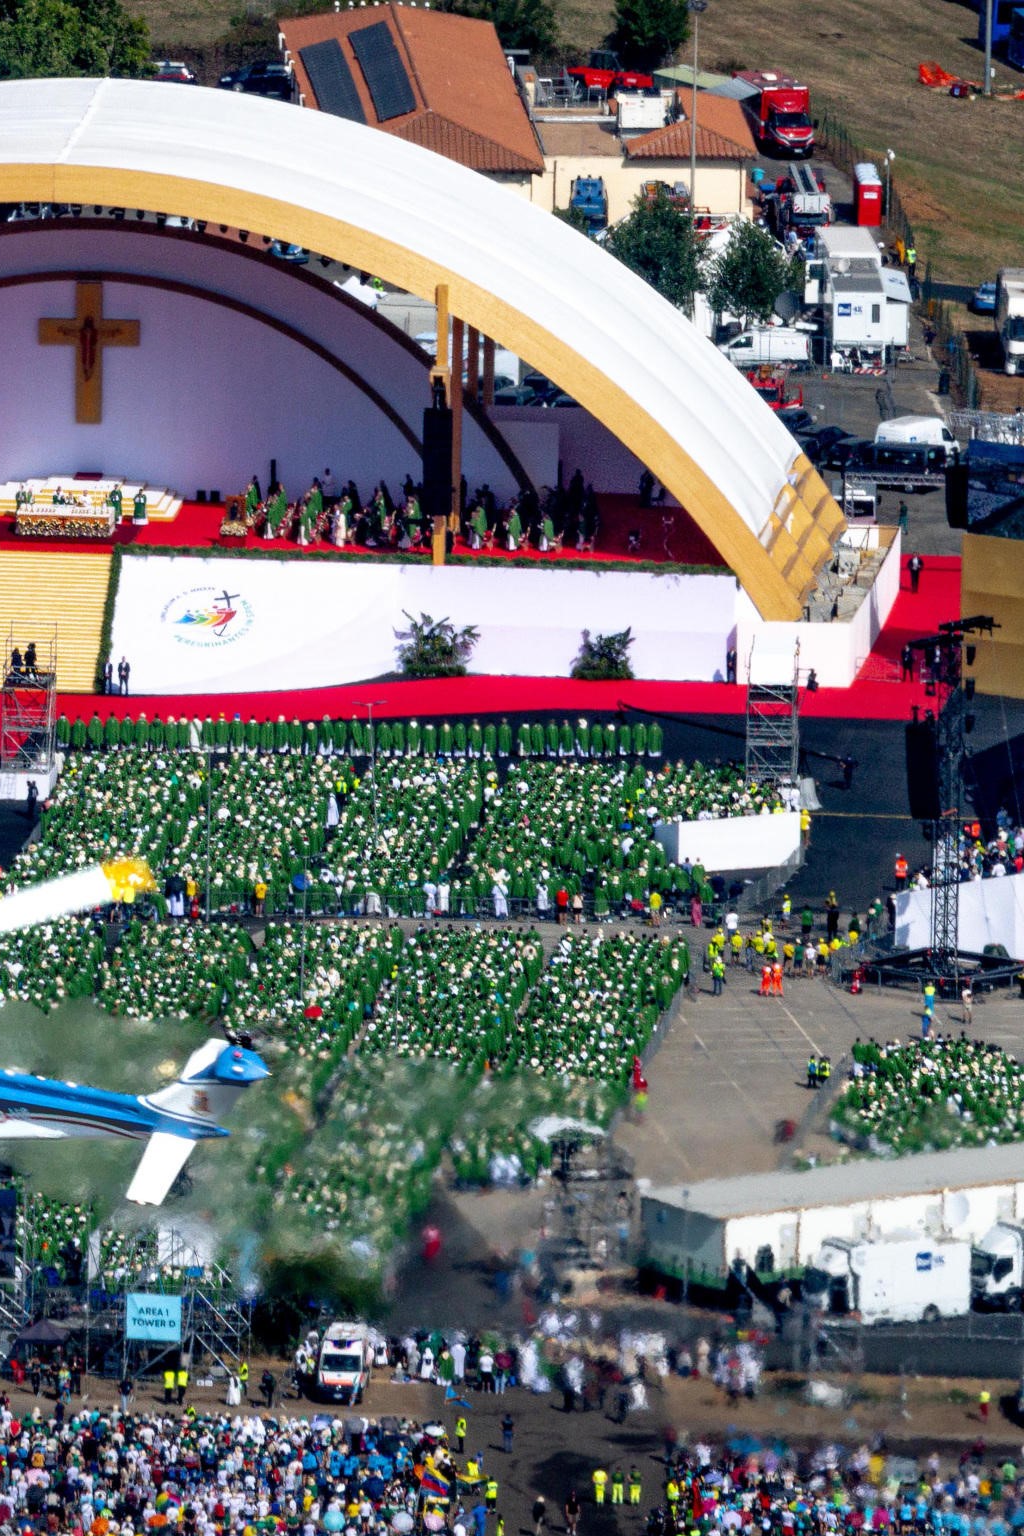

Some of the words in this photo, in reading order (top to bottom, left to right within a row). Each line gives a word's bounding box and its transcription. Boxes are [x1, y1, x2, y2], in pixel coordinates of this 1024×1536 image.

[138, 1307, 164, 1316] AREA
[132, 1317, 166, 1328] TOWER
[169, 1320, 176, 1328] D
